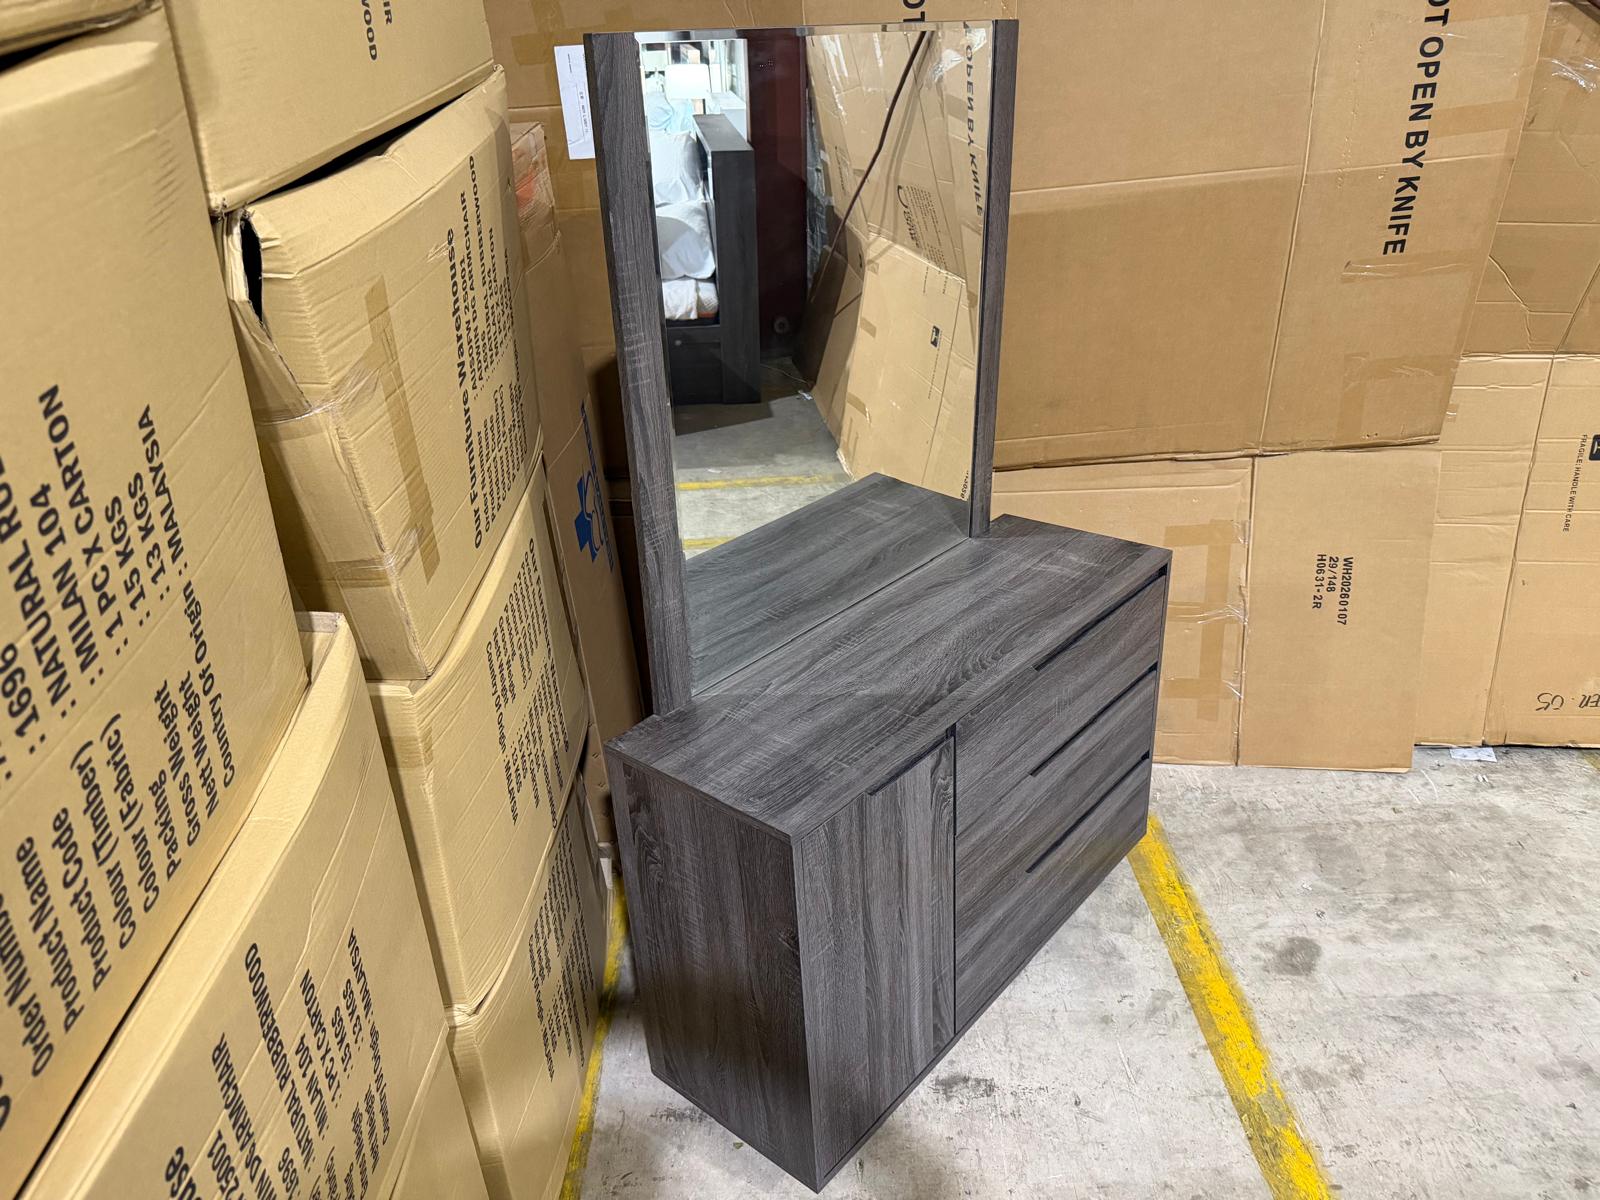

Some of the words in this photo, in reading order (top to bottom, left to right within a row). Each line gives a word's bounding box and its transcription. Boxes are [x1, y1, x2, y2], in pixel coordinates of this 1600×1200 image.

[1409, 36, 1444, 121] OPEN
[1402, 130, 1430, 168] BY
[460, 192, 475, 291] ARMCHAIR
[1383, 176, 1421, 255] KNIFE
[447, 229, 467, 388] Warehouse
[460, 256, 470, 317] 25001
[470, 296, 478, 323] DG
[466, 320, 477, 390] AUSOFW
[474, 326, 484, 381] ADWIN
[38, 385, 93, 535] CARTON
[463, 390, 478, 506] Furniture
[477, 431, 487, 491] Number
[29, 483, 66, 556] 104
[128, 472, 154, 542] KGS
[138, 405, 184, 564] MALAYSIA
[482, 492, 490, 532] Order
[486, 464, 496, 522] Product
[82, 533, 103, 567] X
[105, 496, 134, 568] KGS
[474, 507, 482, 549] Our
[1563, 513, 1572, 532] CARE
[91, 565, 116, 615] PC
[123, 567, 145, 610] 15
[146, 542, 166, 585] 13
[1326, 556, 1339, 593] 29/148
[1337, 556, 1353, 626] WH20260107
[8, 539, 71, 707] NATURAL
[52, 558, 98, 673] MILAN
[105, 611, 123, 638] 1
[182, 580, 207, 664] Origin
[529, 538, 537, 573] Our
[536, 575, 551, 660] Furniture
[551, 658, 569, 752] Warehouse
[199, 662, 215, 697] Of
[486, 641, 498, 697] Country
[154, 680, 186, 781] Weight
[178, 671, 208, 767] Weight
[495, 696, 502, 713] Of
[498, 712, 507, 754] Origin
[100, 713, 143, 831] (Fabric)
[207, 693, 235, 788] Country
[70, 740, 119, 867] (Timber)
[179, 772, 200, 847] Gross
[199, 758, 219, 818] Nett
[505, 760, 518, 825] MALAYSIA
[52, 808, 82, 889] Code
[148, 770, 181, 881] Packing
[16, 837, 54, 933] Name
[106, 861, 136, 949] Colour
[132, 827, 159, 913] Colour
[70, 877, 111, 992] Product
[39, 917, 84, 1033] Product
[343, 978, 358, 1017] KGS
[347, 928, 373, 1020] MALAYSIA
[22, 993, 53, 1077] Order
[245, 943, 291, 1092] RUBBERWOOD
[300, 969, 326, 1051] CARTON
[332, 1006, 347, 1045] KGS
[352, 1015, 363, 1044] 13
[295, 1033, 312, 1078] 104
[320, 1041, 332, 1067] X
[325, 1057, 340, 1091] PC
[341, 1044, 352, 1072] 15
[212, 1033, 254, 1152] ARMCHAIR
[284, 1081, 315, 1170] NATURAL
[306, 1071, 328, 1137] MILAN
[245, 1142, 262, 1182] DG
